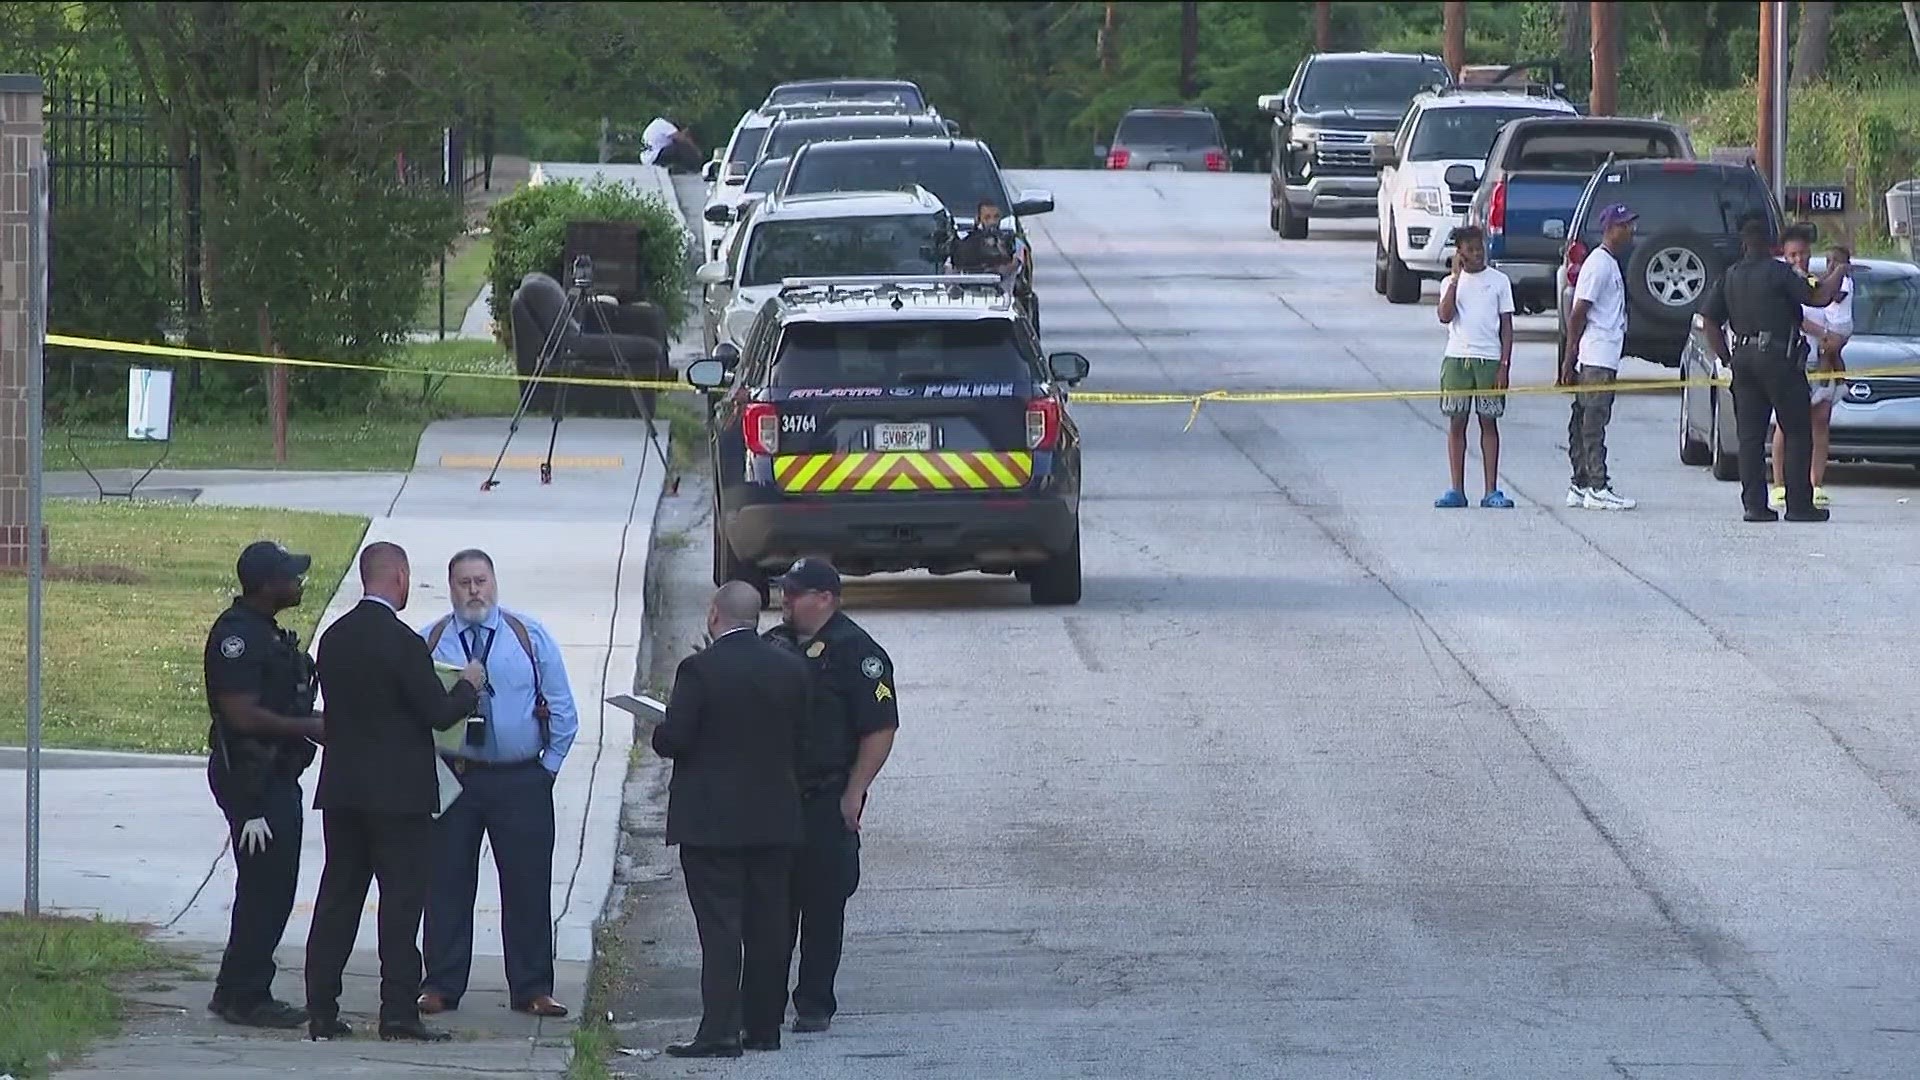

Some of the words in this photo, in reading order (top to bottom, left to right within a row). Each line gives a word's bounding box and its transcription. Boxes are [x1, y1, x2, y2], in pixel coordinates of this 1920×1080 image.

[1813, 192, 1840, 208] 667
[923, 383, 1014, 398] POLICE
[781, 414, 817, 433] 34764
